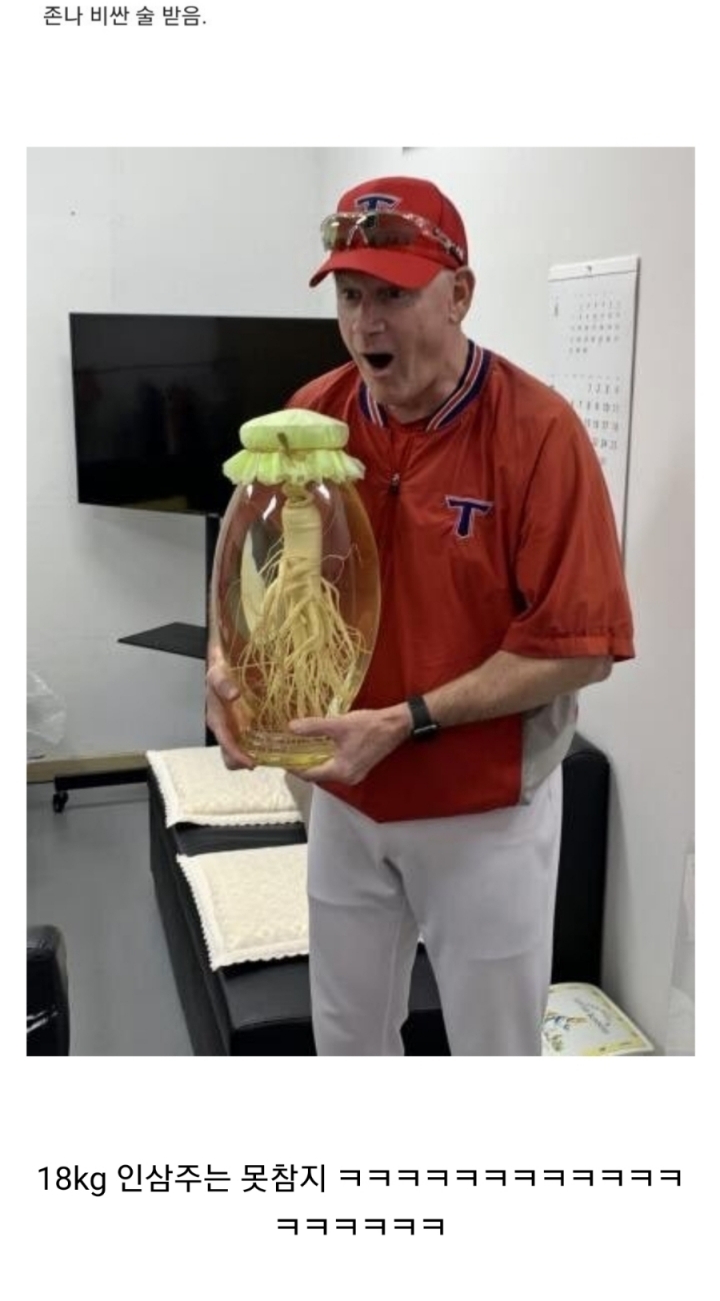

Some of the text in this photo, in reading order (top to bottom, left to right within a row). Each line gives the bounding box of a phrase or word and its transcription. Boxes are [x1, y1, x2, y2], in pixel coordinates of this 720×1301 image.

[44, 5, 207, 27] 존나 비싼 술 받음.
[445, 494, 493, 538] T
